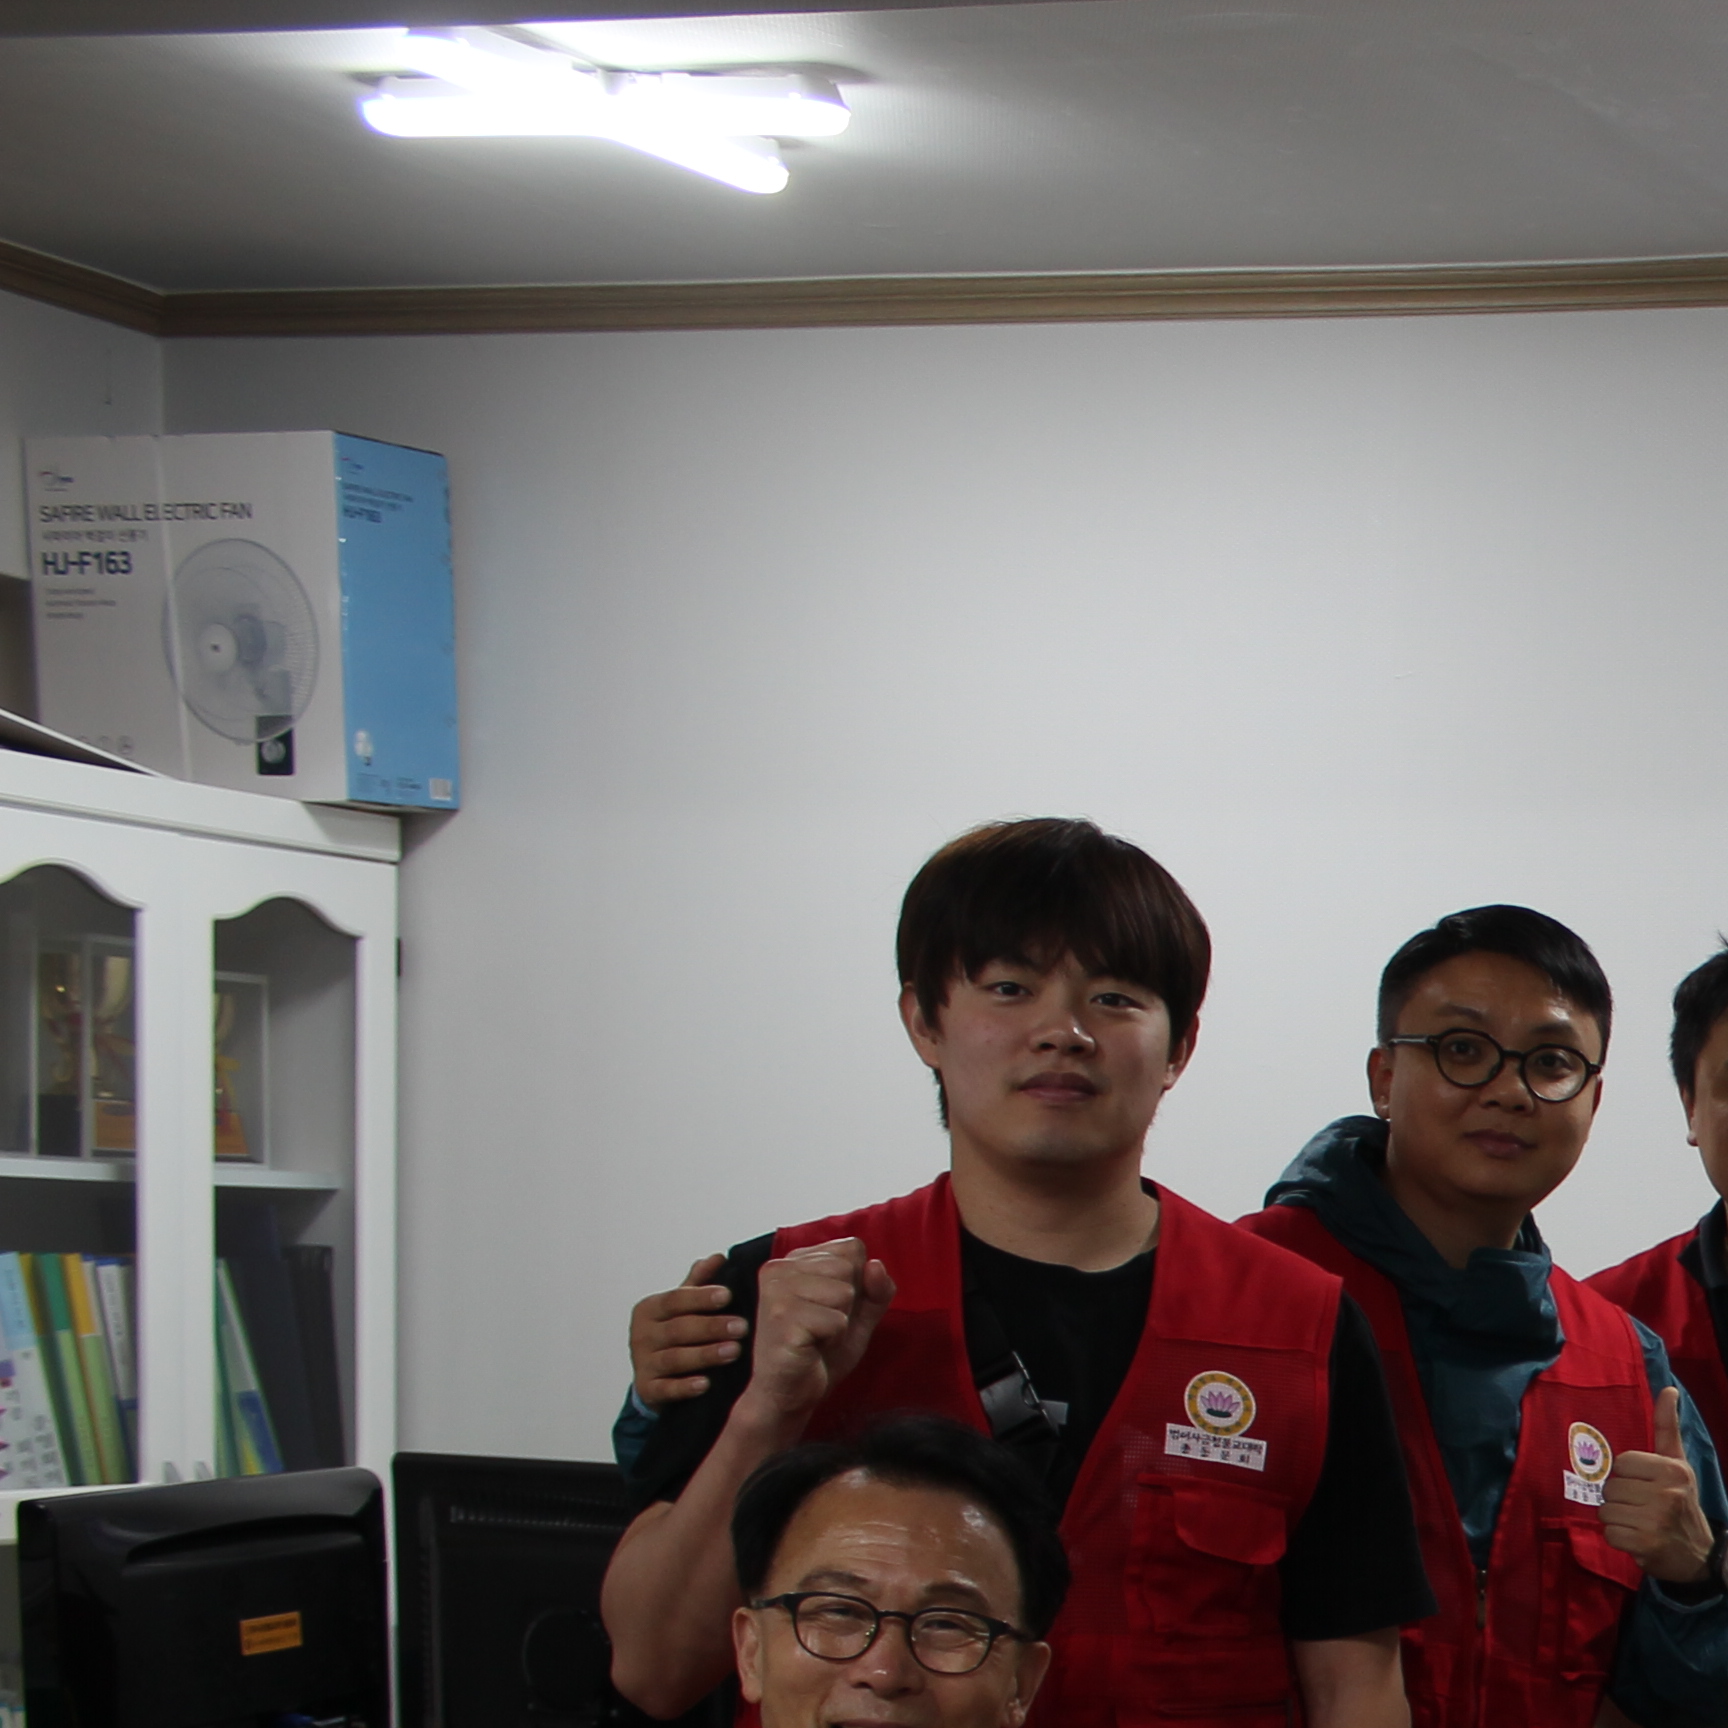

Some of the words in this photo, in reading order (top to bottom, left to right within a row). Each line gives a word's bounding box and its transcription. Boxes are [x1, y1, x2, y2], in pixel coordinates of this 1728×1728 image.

[98, 504, 141, 521] WALL
[144, 503, 217, 521] ELECTRIC
[221, 502, 253, 520] FAN
[42, 551, 134, 575] HJ-F163
